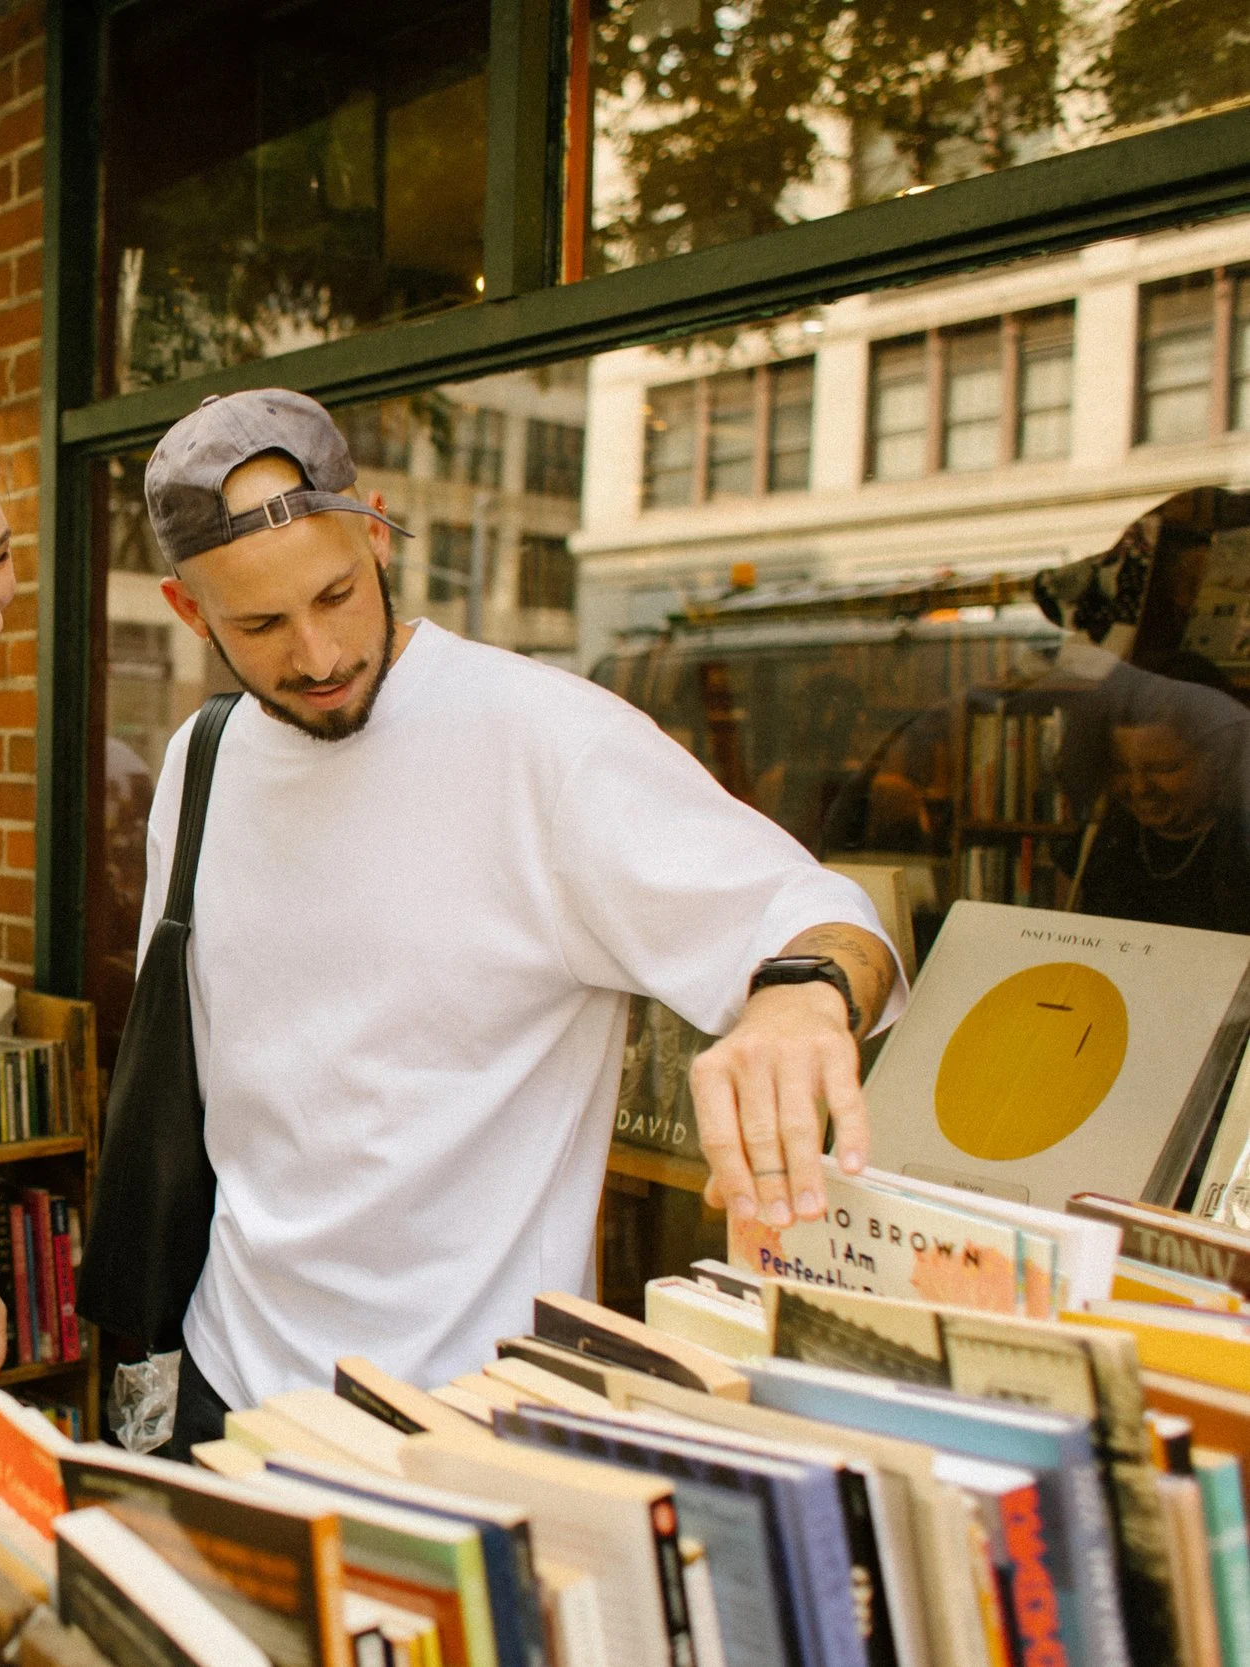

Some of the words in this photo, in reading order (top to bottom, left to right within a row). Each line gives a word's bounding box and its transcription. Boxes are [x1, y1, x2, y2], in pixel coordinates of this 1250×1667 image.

[616, 1108, 687, 1145] DAVID
[828, 1238, 836, 1259] I
[842, 1242, 877, 1273] Am
[868, 1217, 981, 1268] BROWN
[759, 1247, 852, 1291] Perfectl
